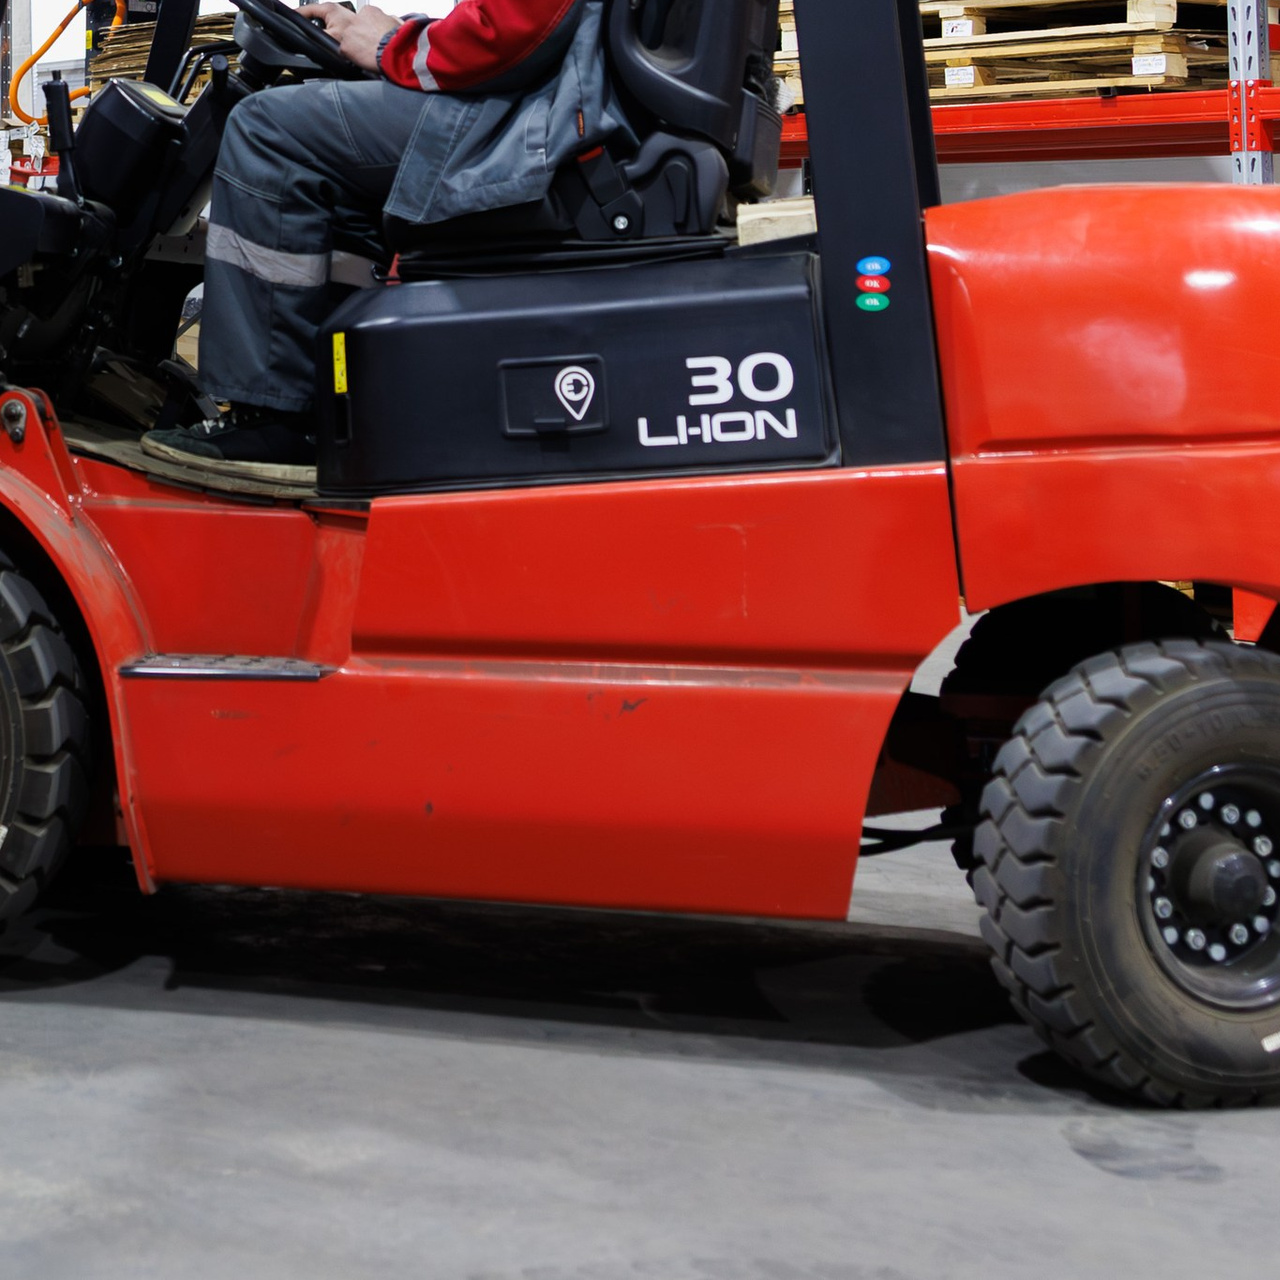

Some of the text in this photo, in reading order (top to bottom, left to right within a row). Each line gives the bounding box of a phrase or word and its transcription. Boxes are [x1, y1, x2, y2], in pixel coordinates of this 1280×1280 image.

[864, 279, 880, 288] OK
[685, 352, 794, 406] 30
[637, 408, 798, 447] LI-ION
